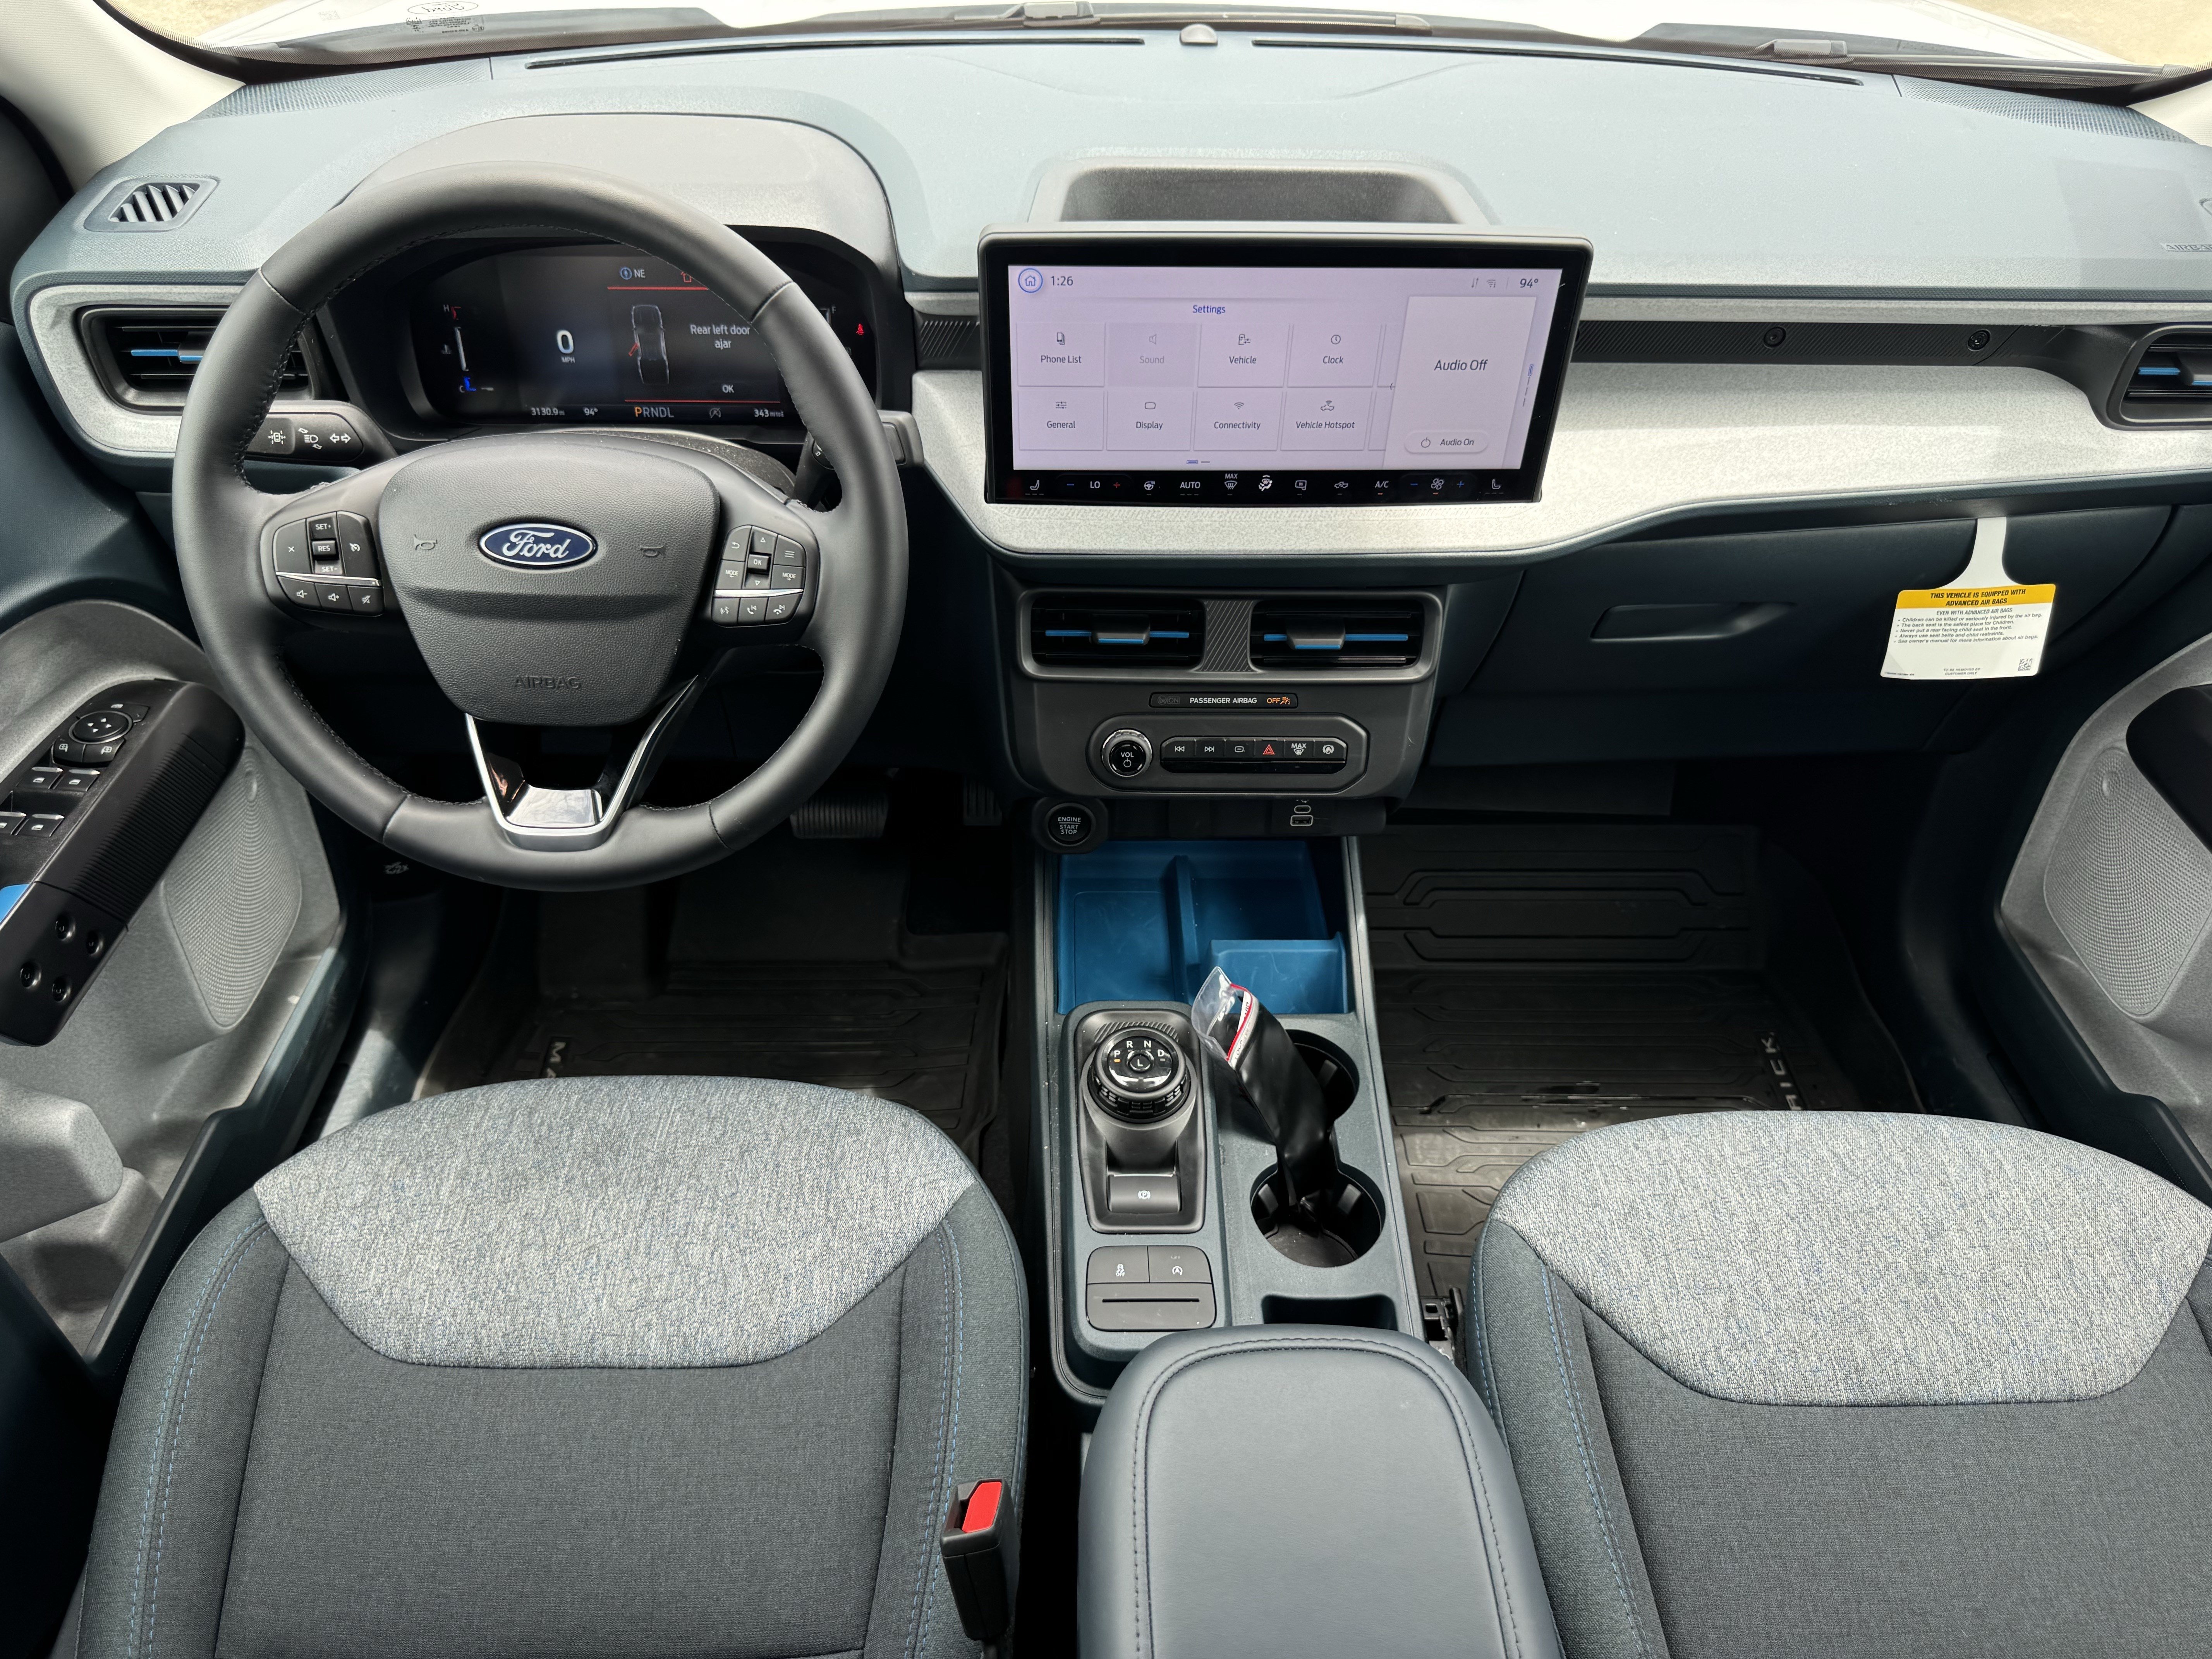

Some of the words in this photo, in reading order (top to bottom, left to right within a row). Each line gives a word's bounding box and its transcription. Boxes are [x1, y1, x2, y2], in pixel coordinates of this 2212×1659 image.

[634, 269, 646, 278] NE
[1051, 275, 1073, 286] 1:26
[1519, 278, 1539, 288] 94°
[1192, 305, 1226, 315] Settings
[690, 324, 711, 335] Rear
[713, 324, 728, 335] left
[730, 324, 750, 335] door
[556, 329, 574, 354] 0
[714, 338, 732, 350] ajar
[1041, 355, 1066, 364] Phone
[1068, 355, 1082, 364] List
[1139, 355, 1164, 364] Sound
[1229, 356, 1257, 364] Vehicle
[1322, 356, 1344, 364] Clock
[1434, 359, 1467, 371] Audio
[1470, 359, 1488, 371] Off
[722, 384, 734, 393] OK
[531, 407, 558, 416] 3130.9
[584, 408, 598, 416] 94°
[754, 409, 769, 417] 343
[1046, 421, 1075, 429] General
[1135, 421, 1163, 430] Display
[1214, 421, 1261, 430] Connectivity
[1324, 421, 1355, 430] Hotspot
[1090, 481, 1101, 489] LO
[1374, 480, 1389, 489] A/C
[503, 529, 571, 559] Ford
[514, 675, 581, 690] AIRBAG
